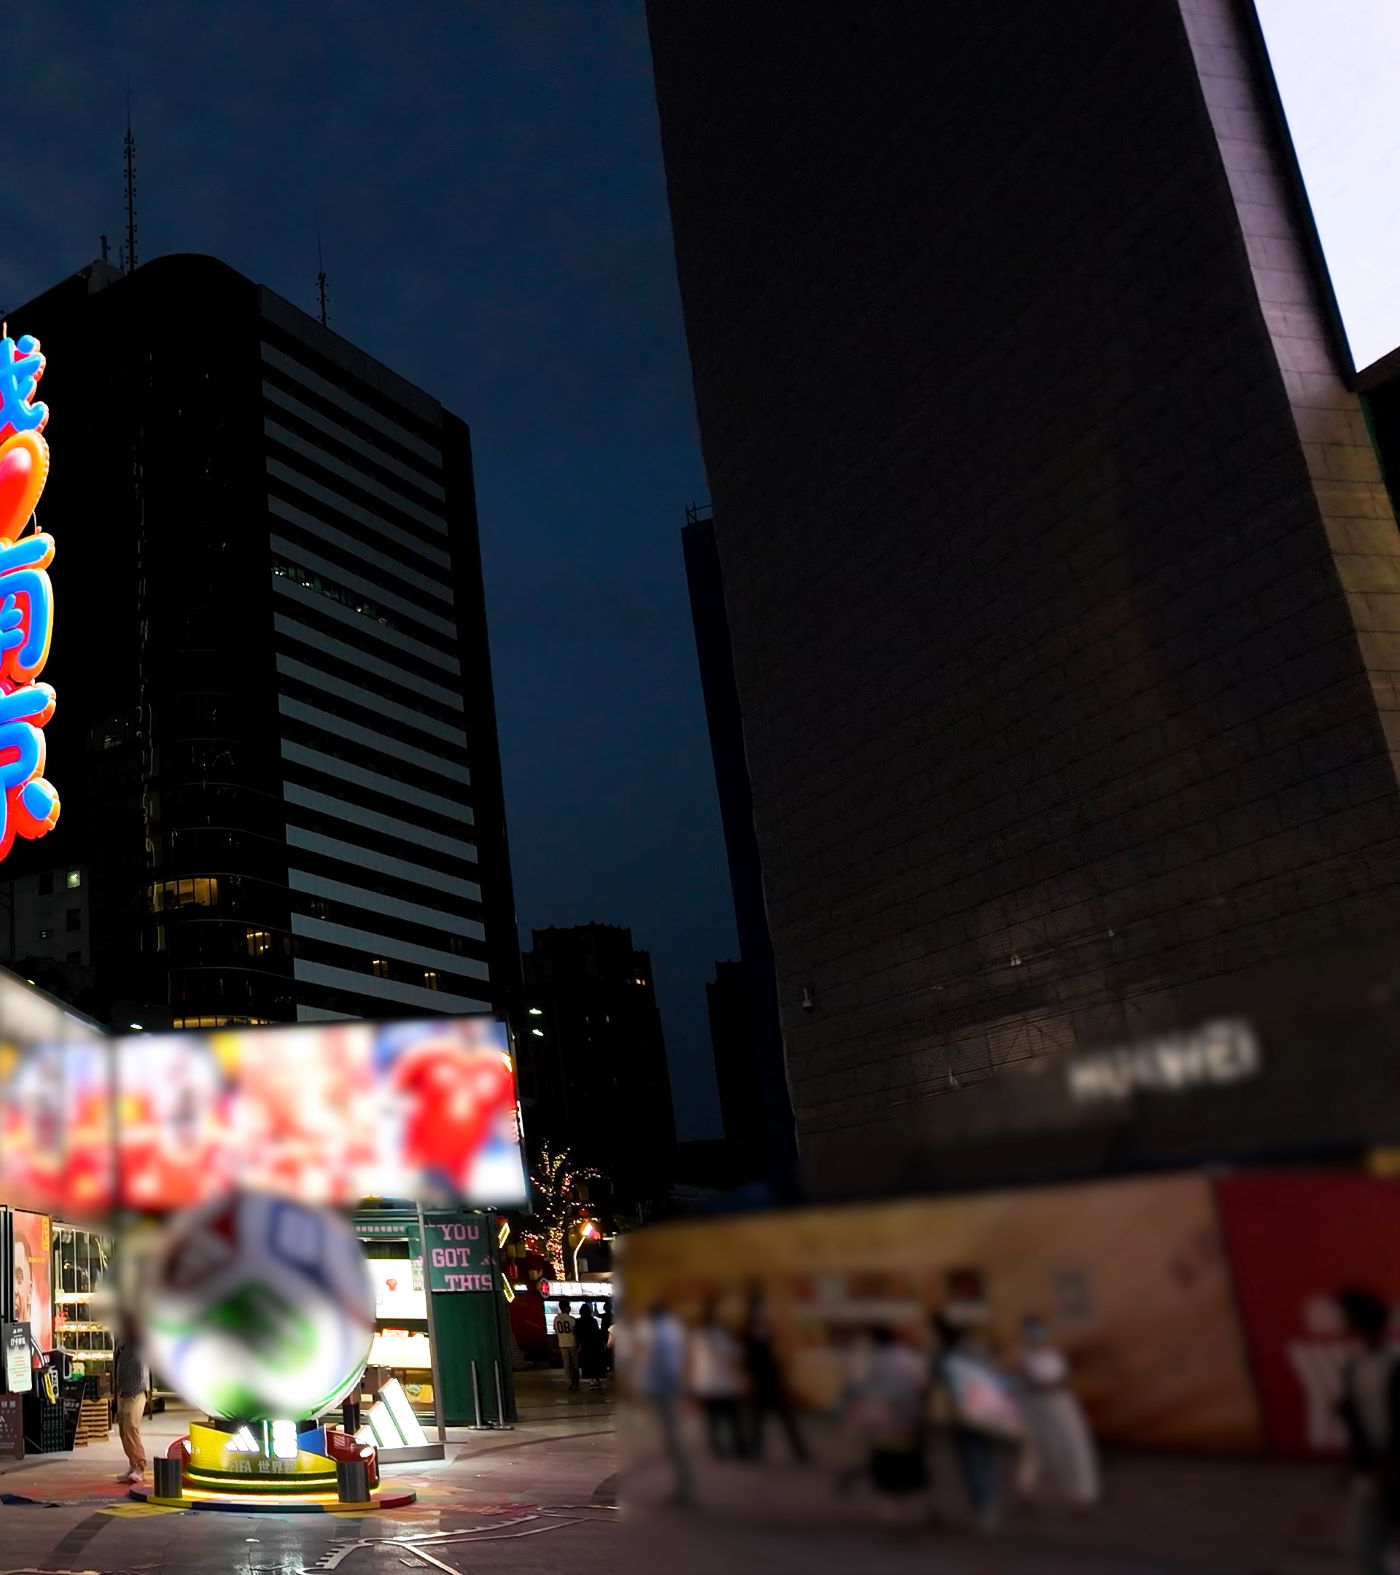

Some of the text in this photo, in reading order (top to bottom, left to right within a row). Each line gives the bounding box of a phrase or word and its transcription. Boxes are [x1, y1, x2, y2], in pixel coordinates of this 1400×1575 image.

[441, 1223, 480, 1241] YOU
[431, 1248, 470, 1268] GOT
[444, 1274, 493, 1292] THIS
